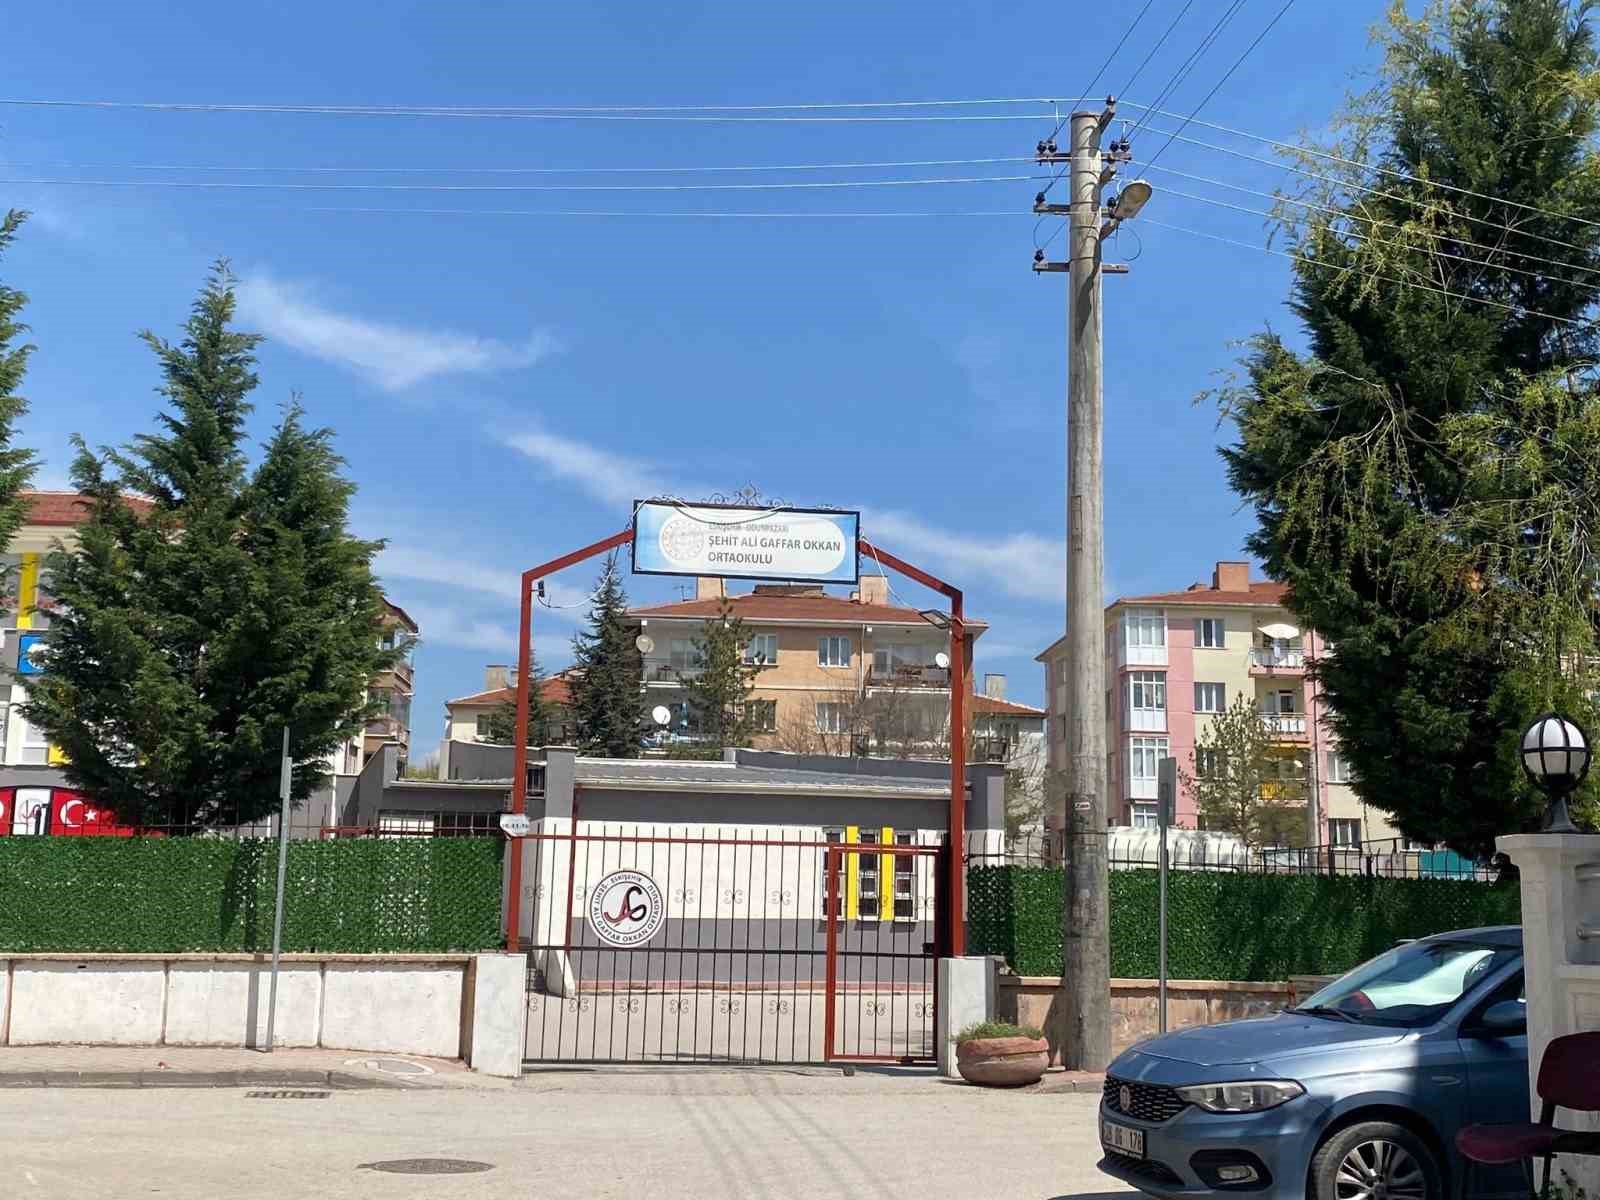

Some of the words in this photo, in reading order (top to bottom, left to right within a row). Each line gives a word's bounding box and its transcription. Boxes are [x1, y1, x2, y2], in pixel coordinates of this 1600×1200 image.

[708, 535, 739, 548] ŞEHİT
[741, 536, 758, 547] ALİ
[760, 537, 801, 549] GAFFAR
[803, 539, 841, 552] OKKAN
[708, 551, 773, 564] ORTAOKULU
[622, 930, 649, 942] OKKAN
[1130, 1131, 1142, 1152] 178
